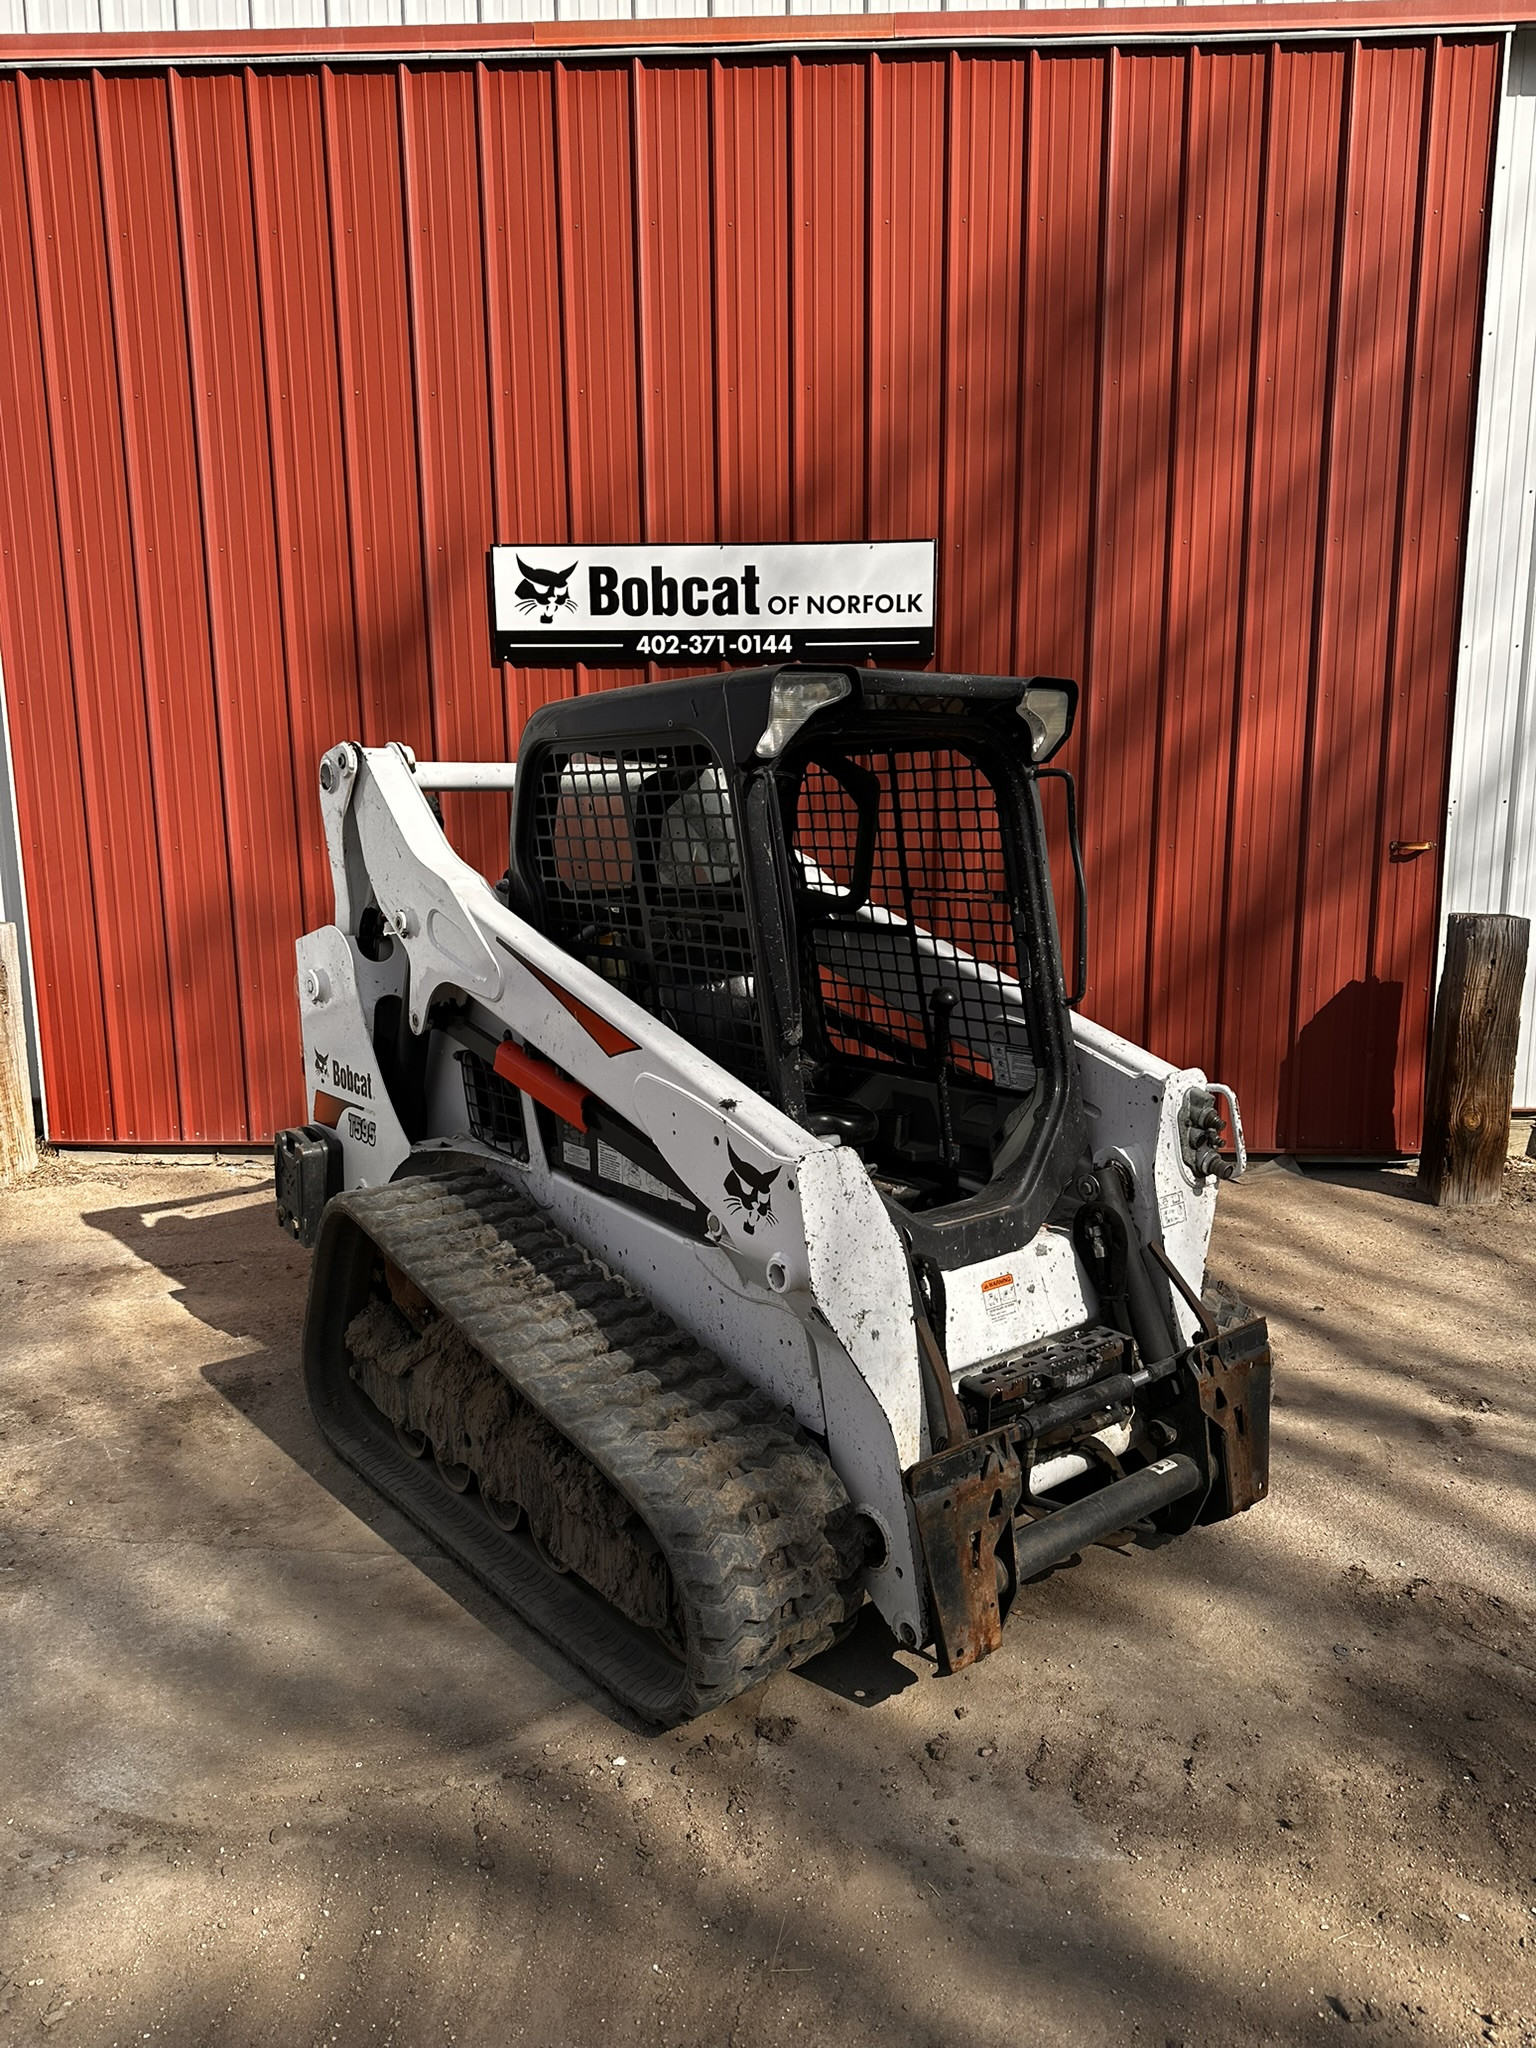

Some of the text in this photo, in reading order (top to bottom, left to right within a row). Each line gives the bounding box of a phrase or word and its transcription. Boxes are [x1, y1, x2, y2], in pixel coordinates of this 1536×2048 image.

[588, 565, 923, 617] Bobcat OF NORFOLK
[636, 635, 793, 656] 402-371-0144
[333, 1060, 373, 1099] Bobcat
[348, 1112, 376, 1147] T595
[989, 1276, 1012, 1288] WARNING
